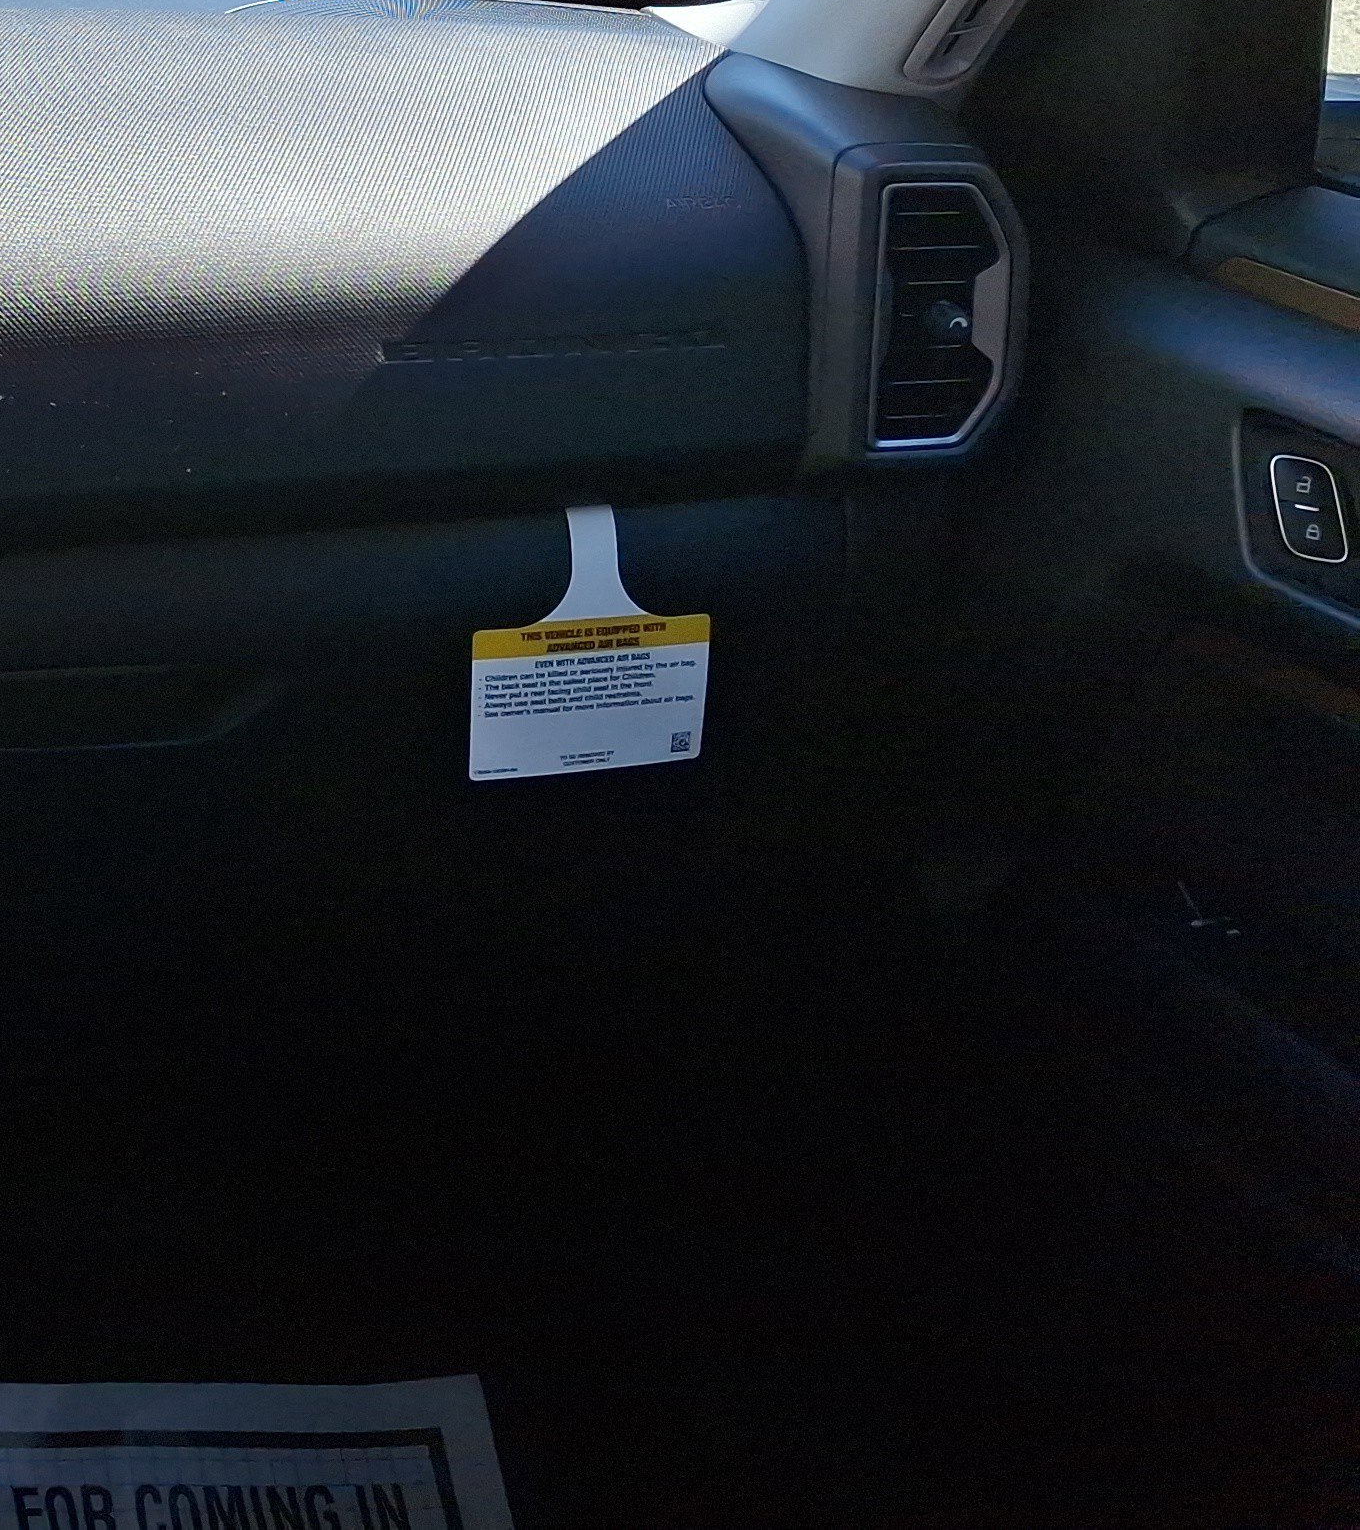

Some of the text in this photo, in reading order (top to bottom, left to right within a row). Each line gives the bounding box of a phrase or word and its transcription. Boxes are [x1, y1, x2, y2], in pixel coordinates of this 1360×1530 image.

[12, 1484, 117, 1530] FOR
[134, 1484, 340, 1530] COMING
[355, 1484, 410, 1530] IN
